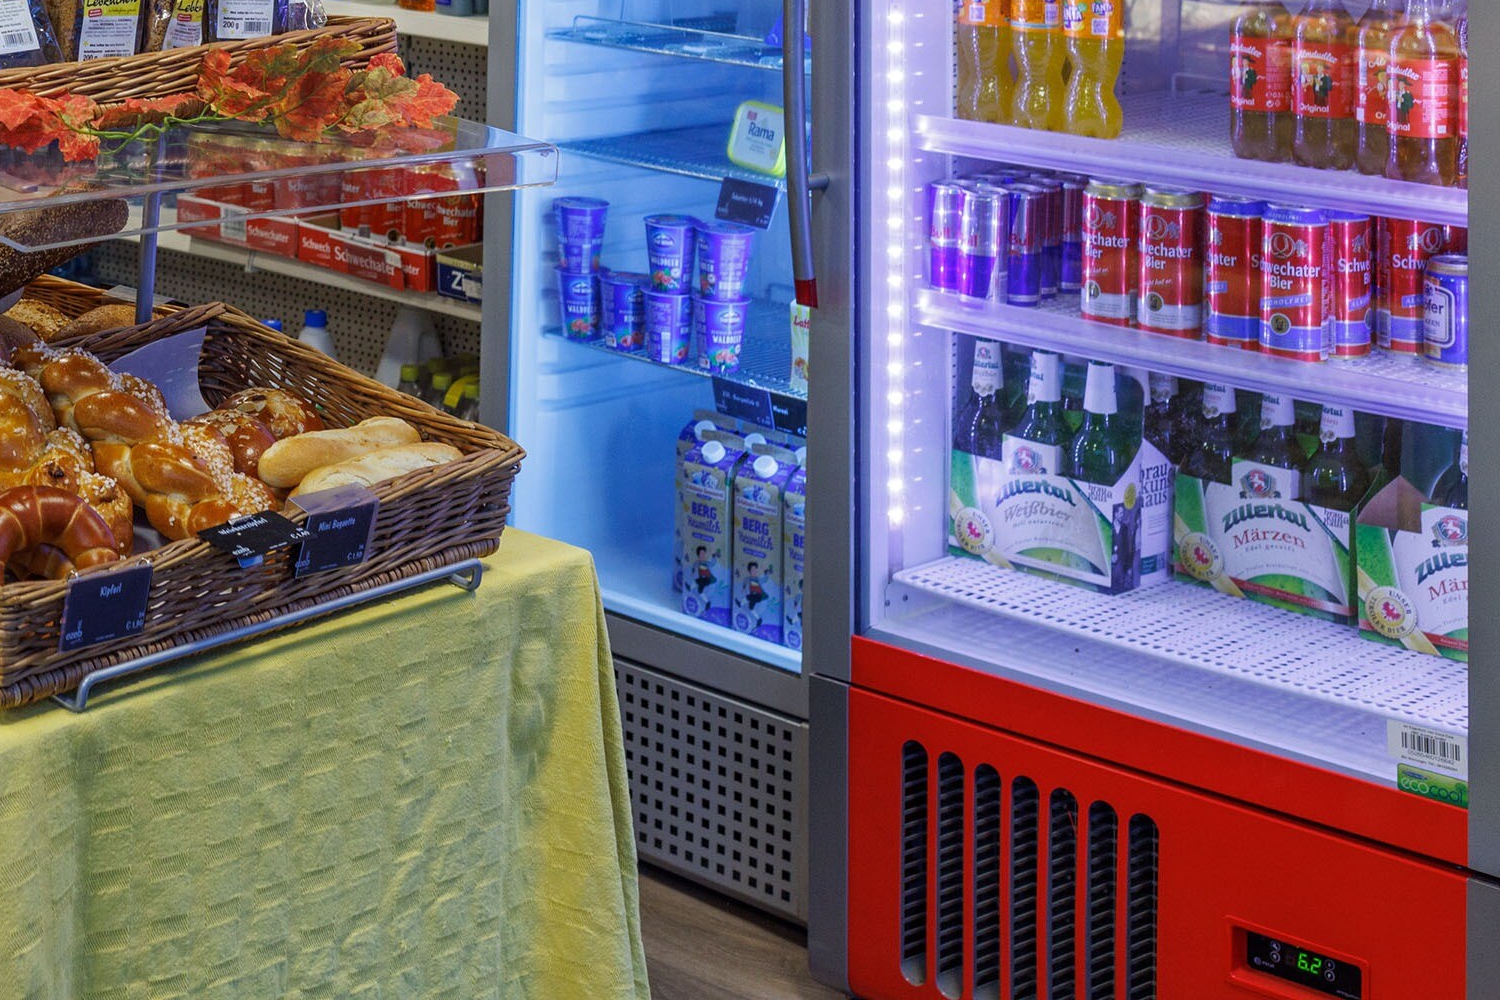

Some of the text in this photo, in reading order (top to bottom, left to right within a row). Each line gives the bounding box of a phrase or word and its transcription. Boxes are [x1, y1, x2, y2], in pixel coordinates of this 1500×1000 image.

[222, 21, 235, 29] 200
[1299, 102, 1330, 114] Original
[748, 120, 775, 142] Rama
[443, 215, 460, 227] Bier
[301, 236, 332, 253] Schwech
[333, 245, 396, 277] Schwechater
[1145, 254, 1167, 271] Bier
[1251, 253, 1321, 279] Schwechater
[1270, 276, 1294, 291] Bier
[691, 502, 717, 521] BERG
[1003, 500, 1071, 524] Weißbier
[1221, 502, 1312, 534] Zillertal
[318, 516, 357, 532] Mini Baguette
[742, 516, 769, 537] BERG
[1232, 528, 1306, 550] Märzen
[1414, 551, 1468, 586] Zille
[99, 582, 123, 598] Kipferl
[1297, 952, 1322, 975] 6.2
